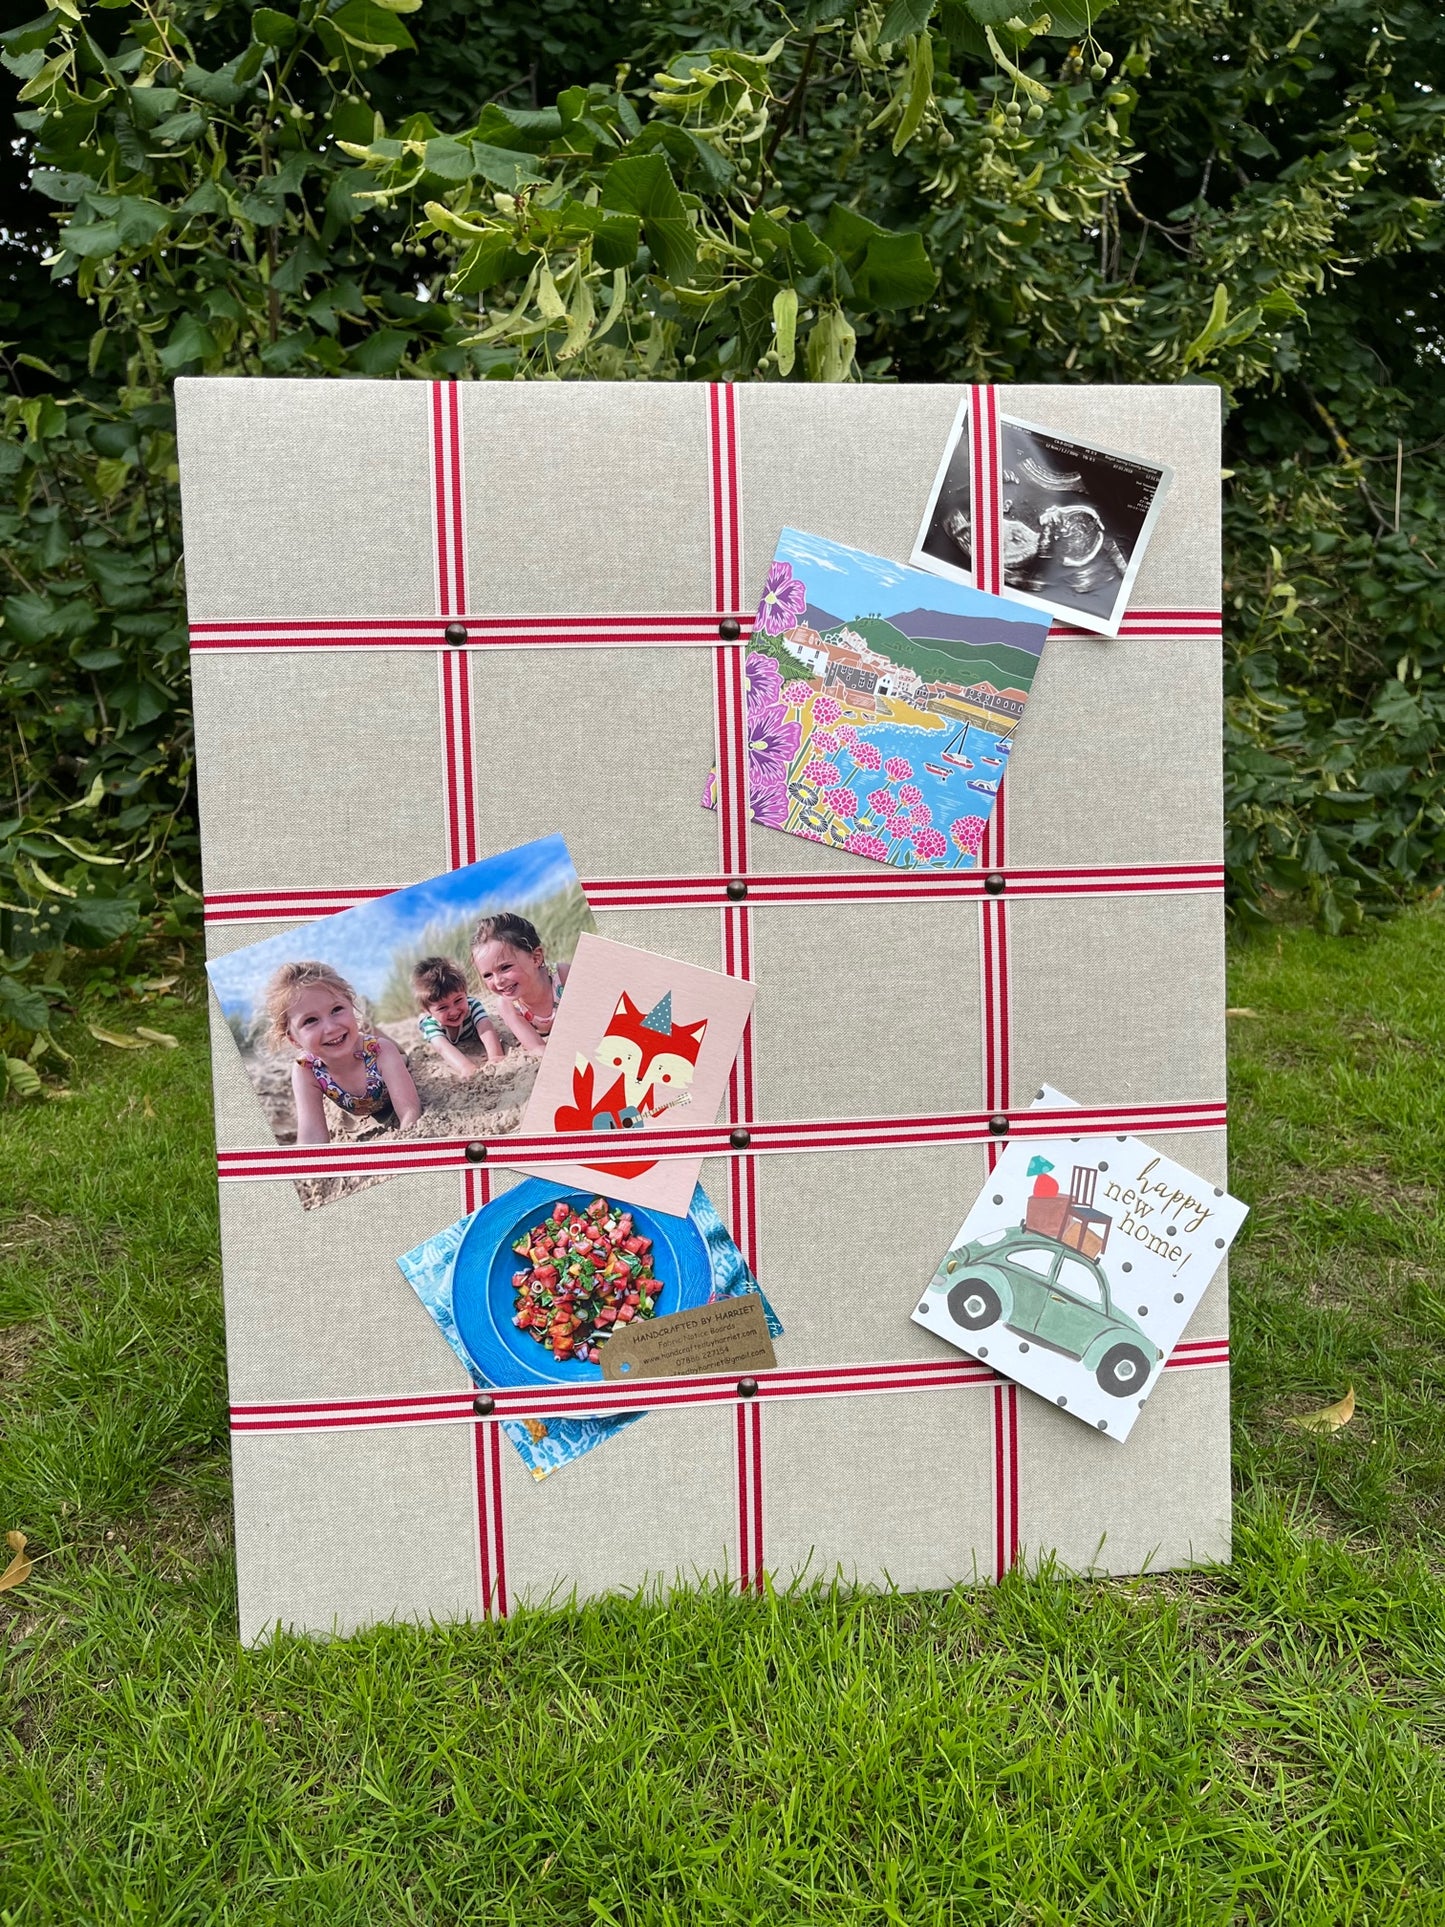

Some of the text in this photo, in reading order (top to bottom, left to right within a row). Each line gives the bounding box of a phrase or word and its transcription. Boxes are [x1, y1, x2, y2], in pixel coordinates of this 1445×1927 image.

[1103, 1181, 1155, 1219] new
[1136, 1157, 1216, 1233] happy
[1116, 1210, 1193, 1278] home!
[632, 1304, 756, 1344] HANDCRAFTED BY HARRIET
[683, 1331, 709, 1342] Notice
[709, 1323, 736, 1335] Boards
[642, 1328, 758, 1365] www.handcraftedbyharriet.com
